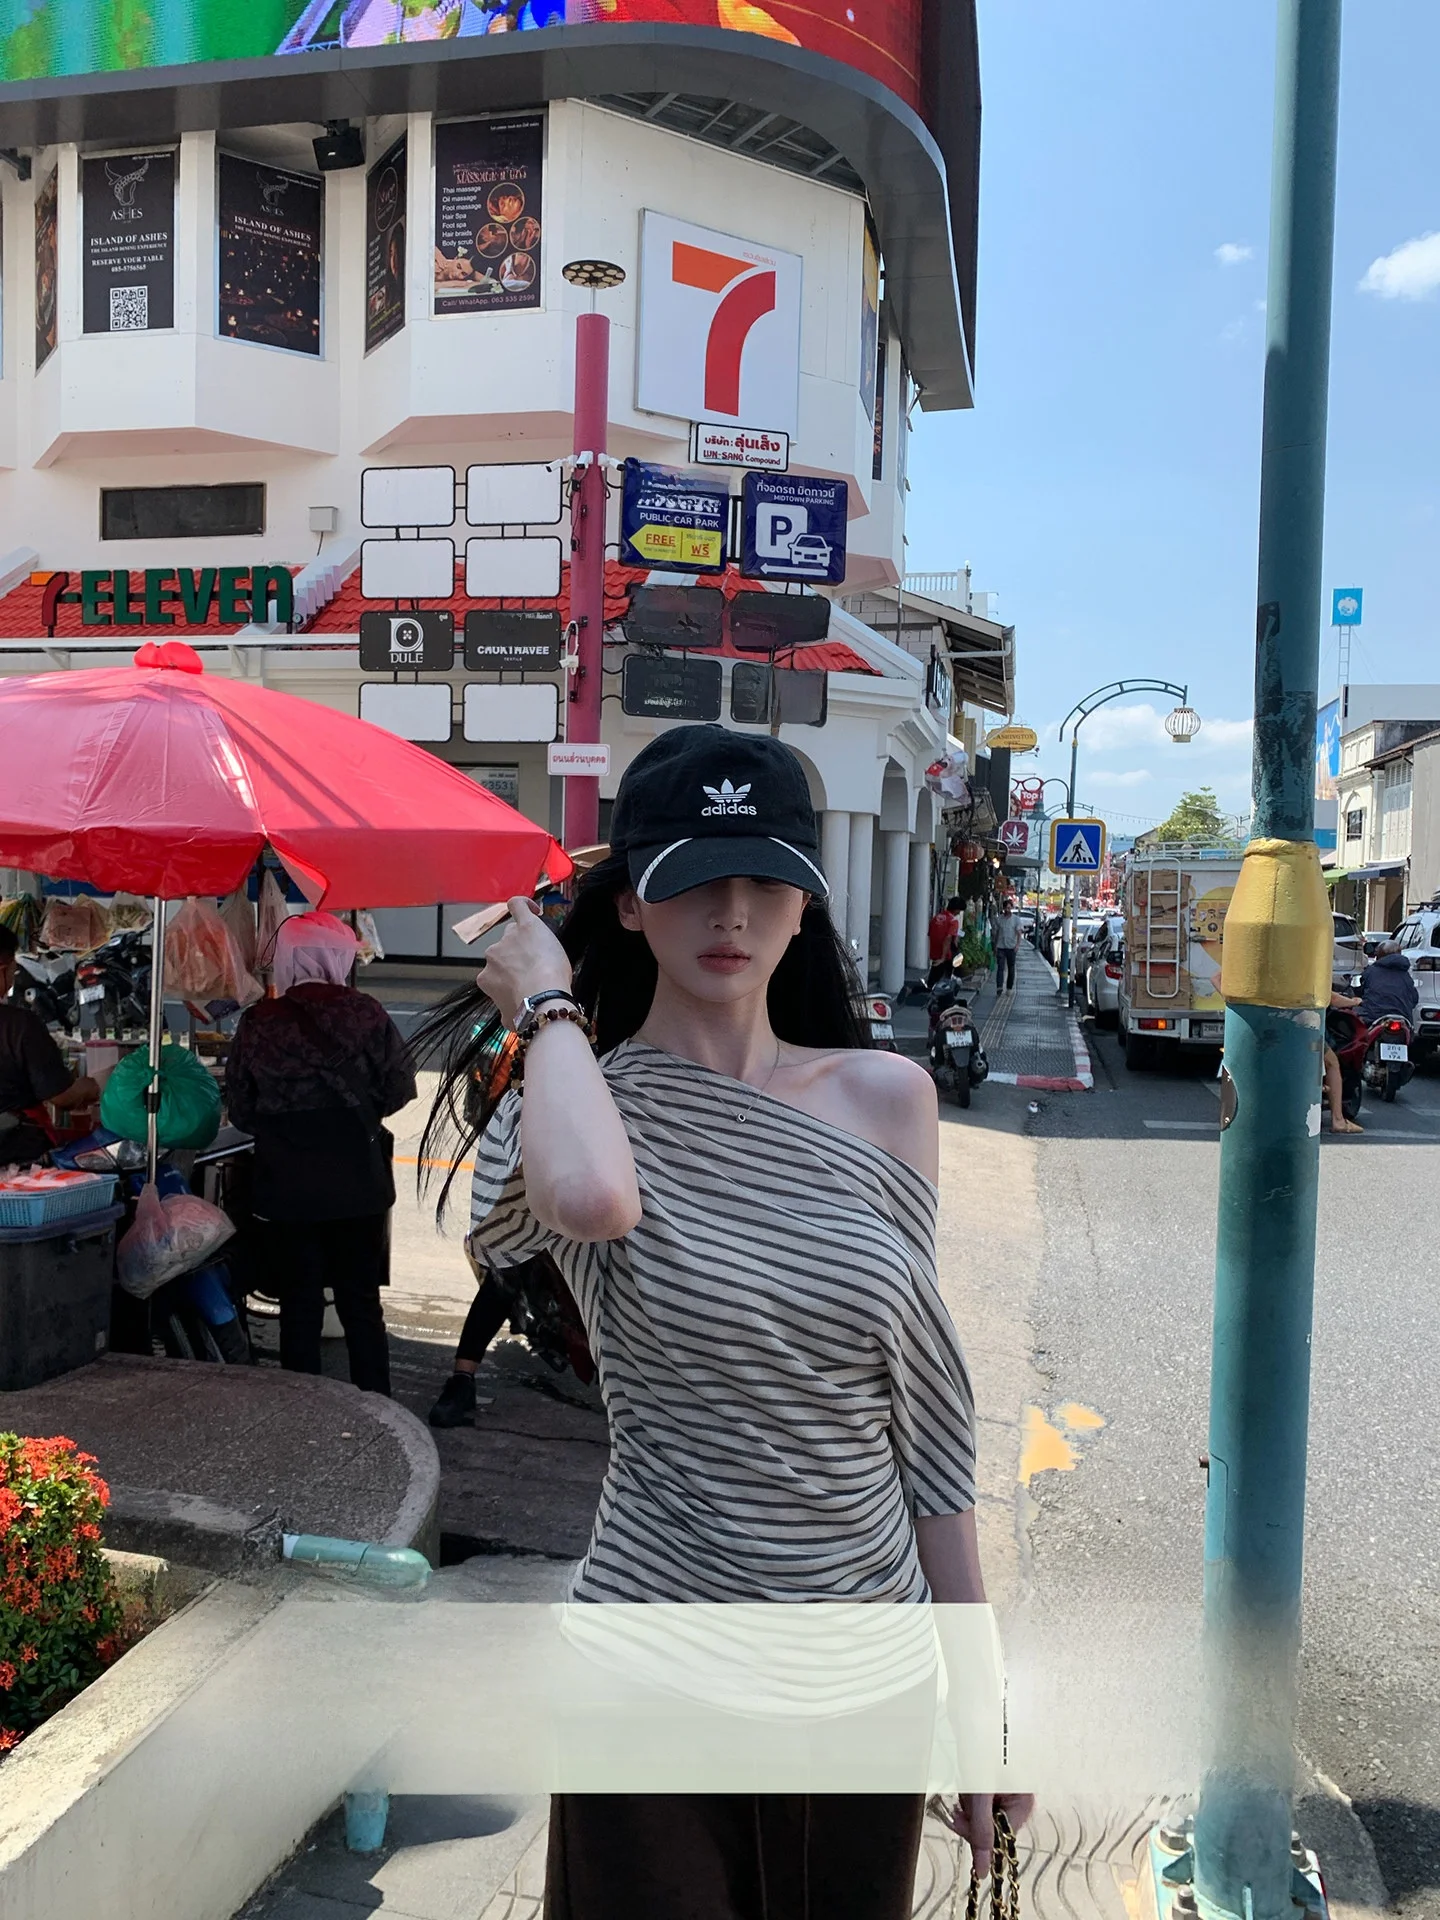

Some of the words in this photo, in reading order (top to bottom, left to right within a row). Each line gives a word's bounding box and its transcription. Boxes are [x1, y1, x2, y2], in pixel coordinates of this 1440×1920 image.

[234, 215, 268, 230] ISLAND
[269, 224, 282, 234] OF
[283, 229, 311, 241] ASHES
[91, 235, 123, 246] ISLAND
[125, 234, 137, 243] OF
[139, 232, 168, 242] ASHES
[91, 258, 121, 266] RESERVE
[122, 256, 142, 264] YOUR
[745, 454, 781, 465] Compound
[756, 480, 795, 495] ที่จอดรถ
[797, 485, 835, 498] มิดทาวน์
[774, 494, 805, 503] MIDTOWN
[805, 497, 834, 506] PARKING
[640, 512, 671, 523] PUBLIC
[674, 516, 692, 526] CAR
[695, 518, 719, 528] PARK
[770, 515, 793, 546] P
[645, 533, 676, 545] FREE
[701, 803, 758, 817] adidas
